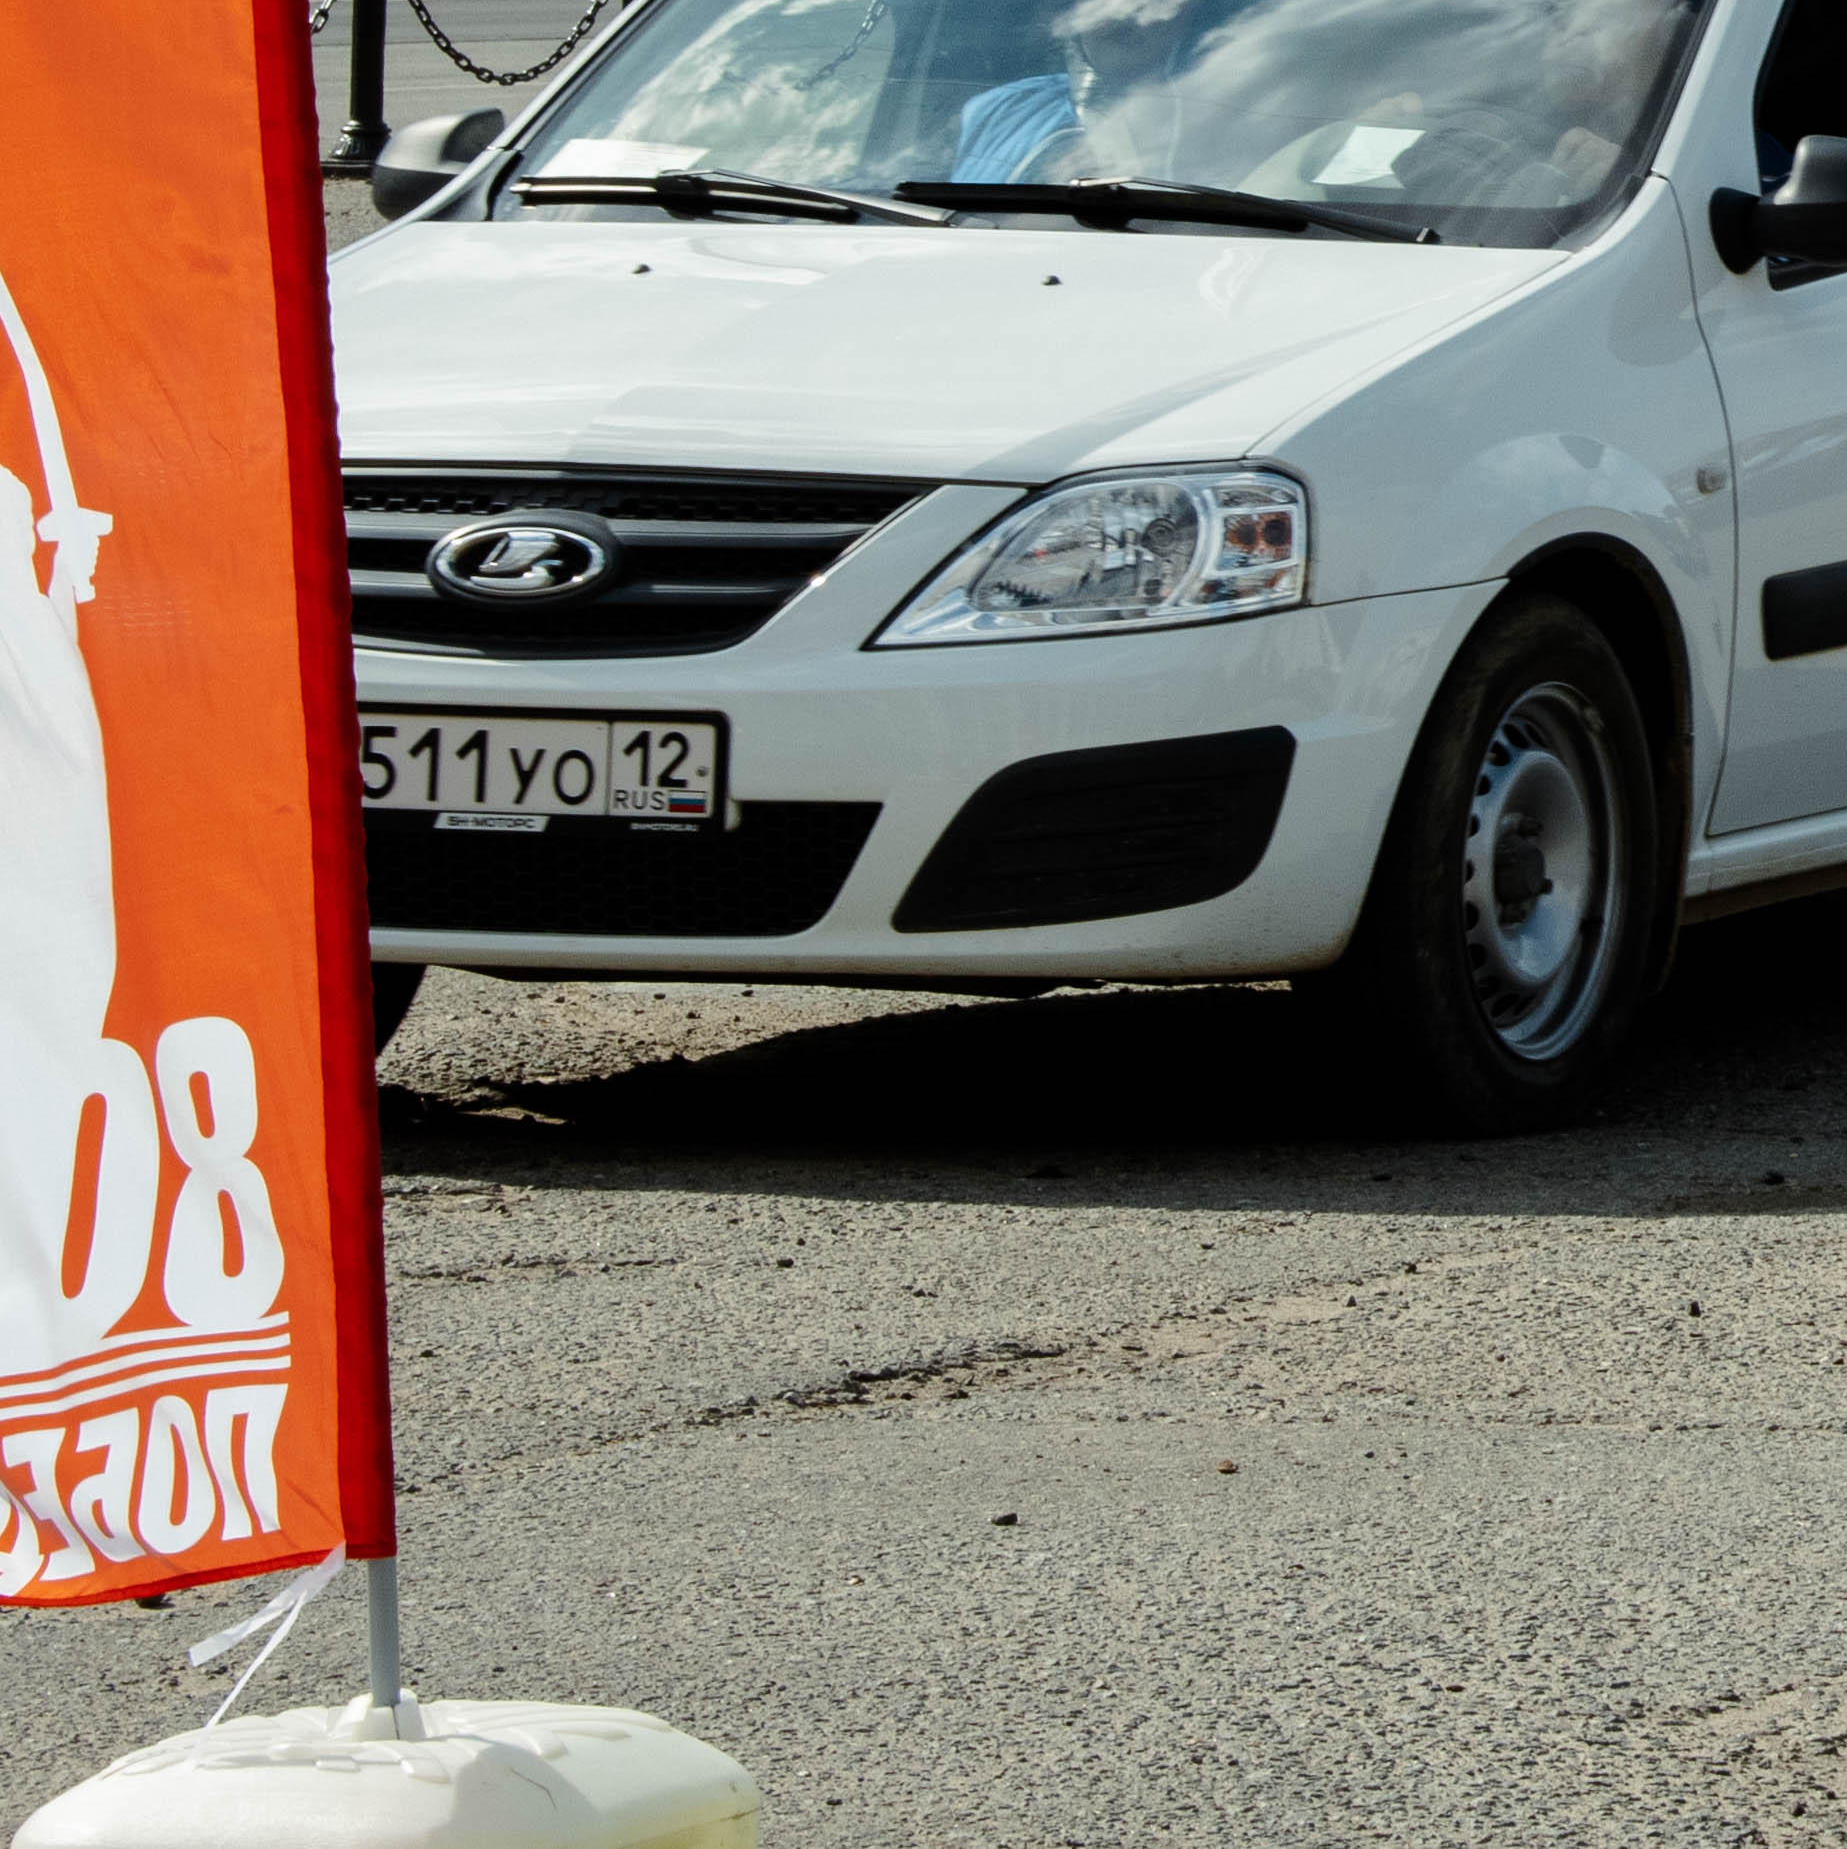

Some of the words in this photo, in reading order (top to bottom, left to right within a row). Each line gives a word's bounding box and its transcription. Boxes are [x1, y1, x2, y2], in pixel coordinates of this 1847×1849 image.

[362, 726, 595, 806] 511УО
[623, 730, 690, 789] 12
[612, 790, 666, 811] RUS
